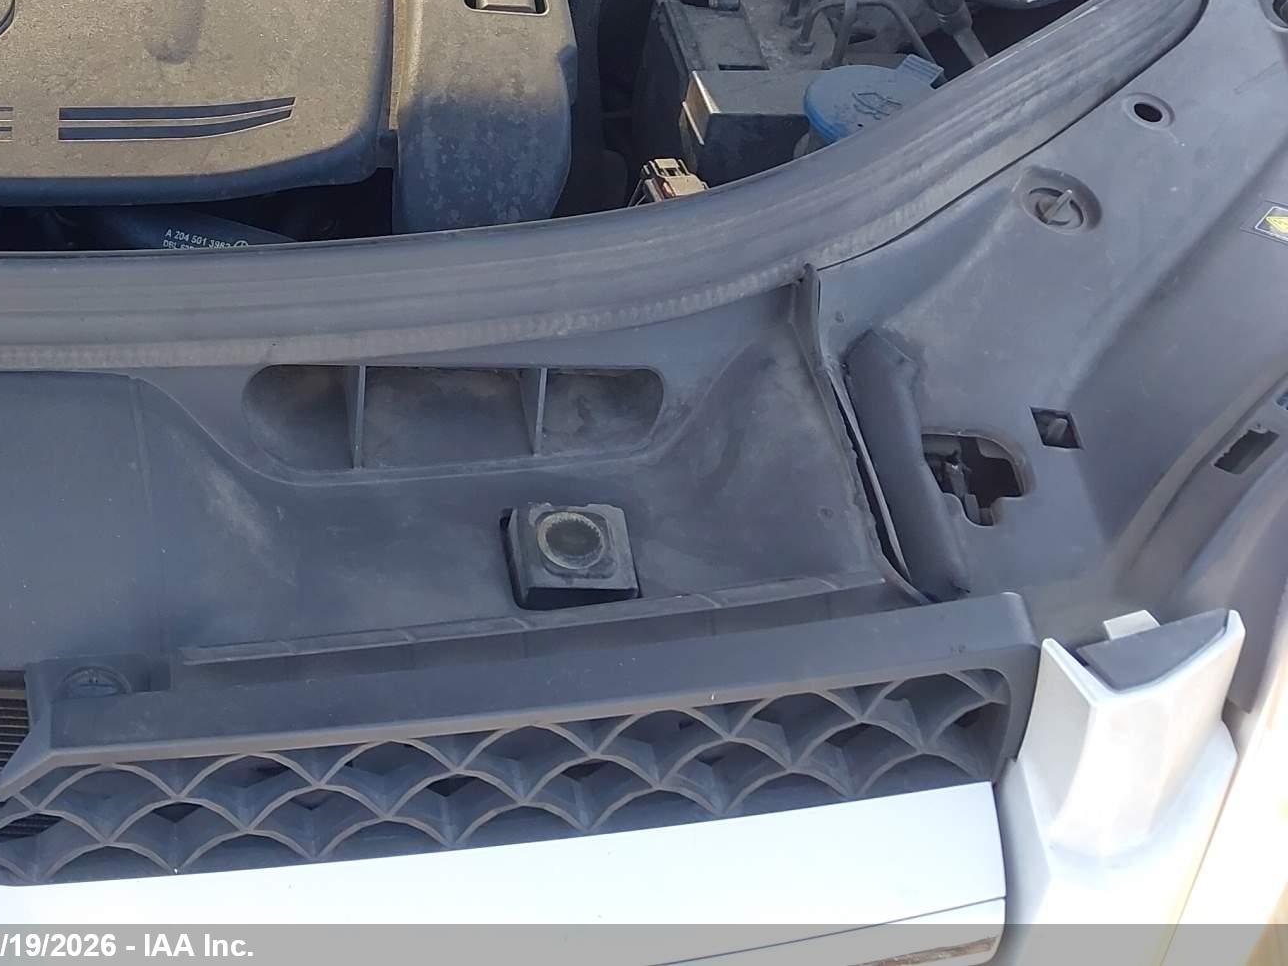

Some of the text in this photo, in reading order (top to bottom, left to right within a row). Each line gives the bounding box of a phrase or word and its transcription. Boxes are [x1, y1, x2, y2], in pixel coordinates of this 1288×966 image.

[165, 229, 172, 238] A
[174, 230, 190, 242] 204
[191, 235, 207, 246] 501
